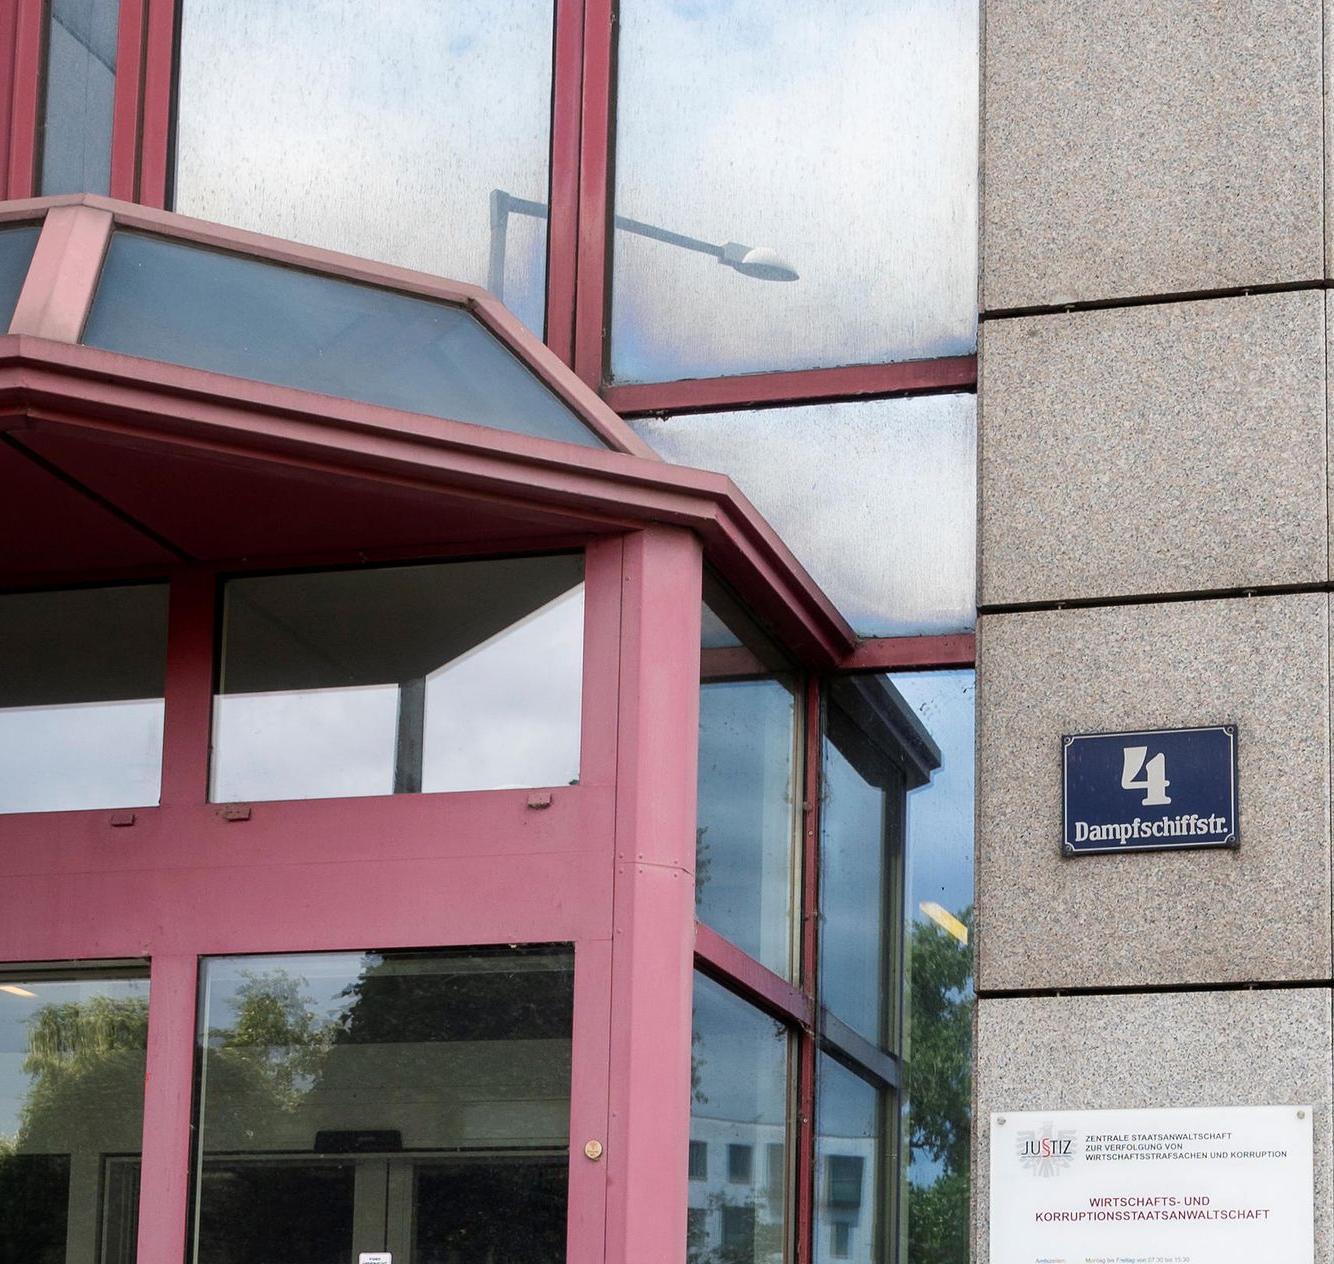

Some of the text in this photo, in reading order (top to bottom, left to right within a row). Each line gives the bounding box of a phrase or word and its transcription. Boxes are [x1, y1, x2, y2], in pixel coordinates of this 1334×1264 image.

[1121, 746, 1172, 806] 4
[1075, 813, 1228, 844] Dampfschiffstr.
[1085, 1132, 1232, 1142] ZENTRALE STAATSANWALTSCHAFT
[1104, 1143, 1163, 1151] VERFOLGUNG
[1085, 1150, 1287, 1161] WIRTSCHAFTSSTRAFSACHEN UND KORRUPTION
[1089, 1196, 1210, 1208] WIRTSCHAFTS- UND
[1036, 1209, 1270, 1222] KORRUPTIONSSTAATSANWALTSCHAFT
